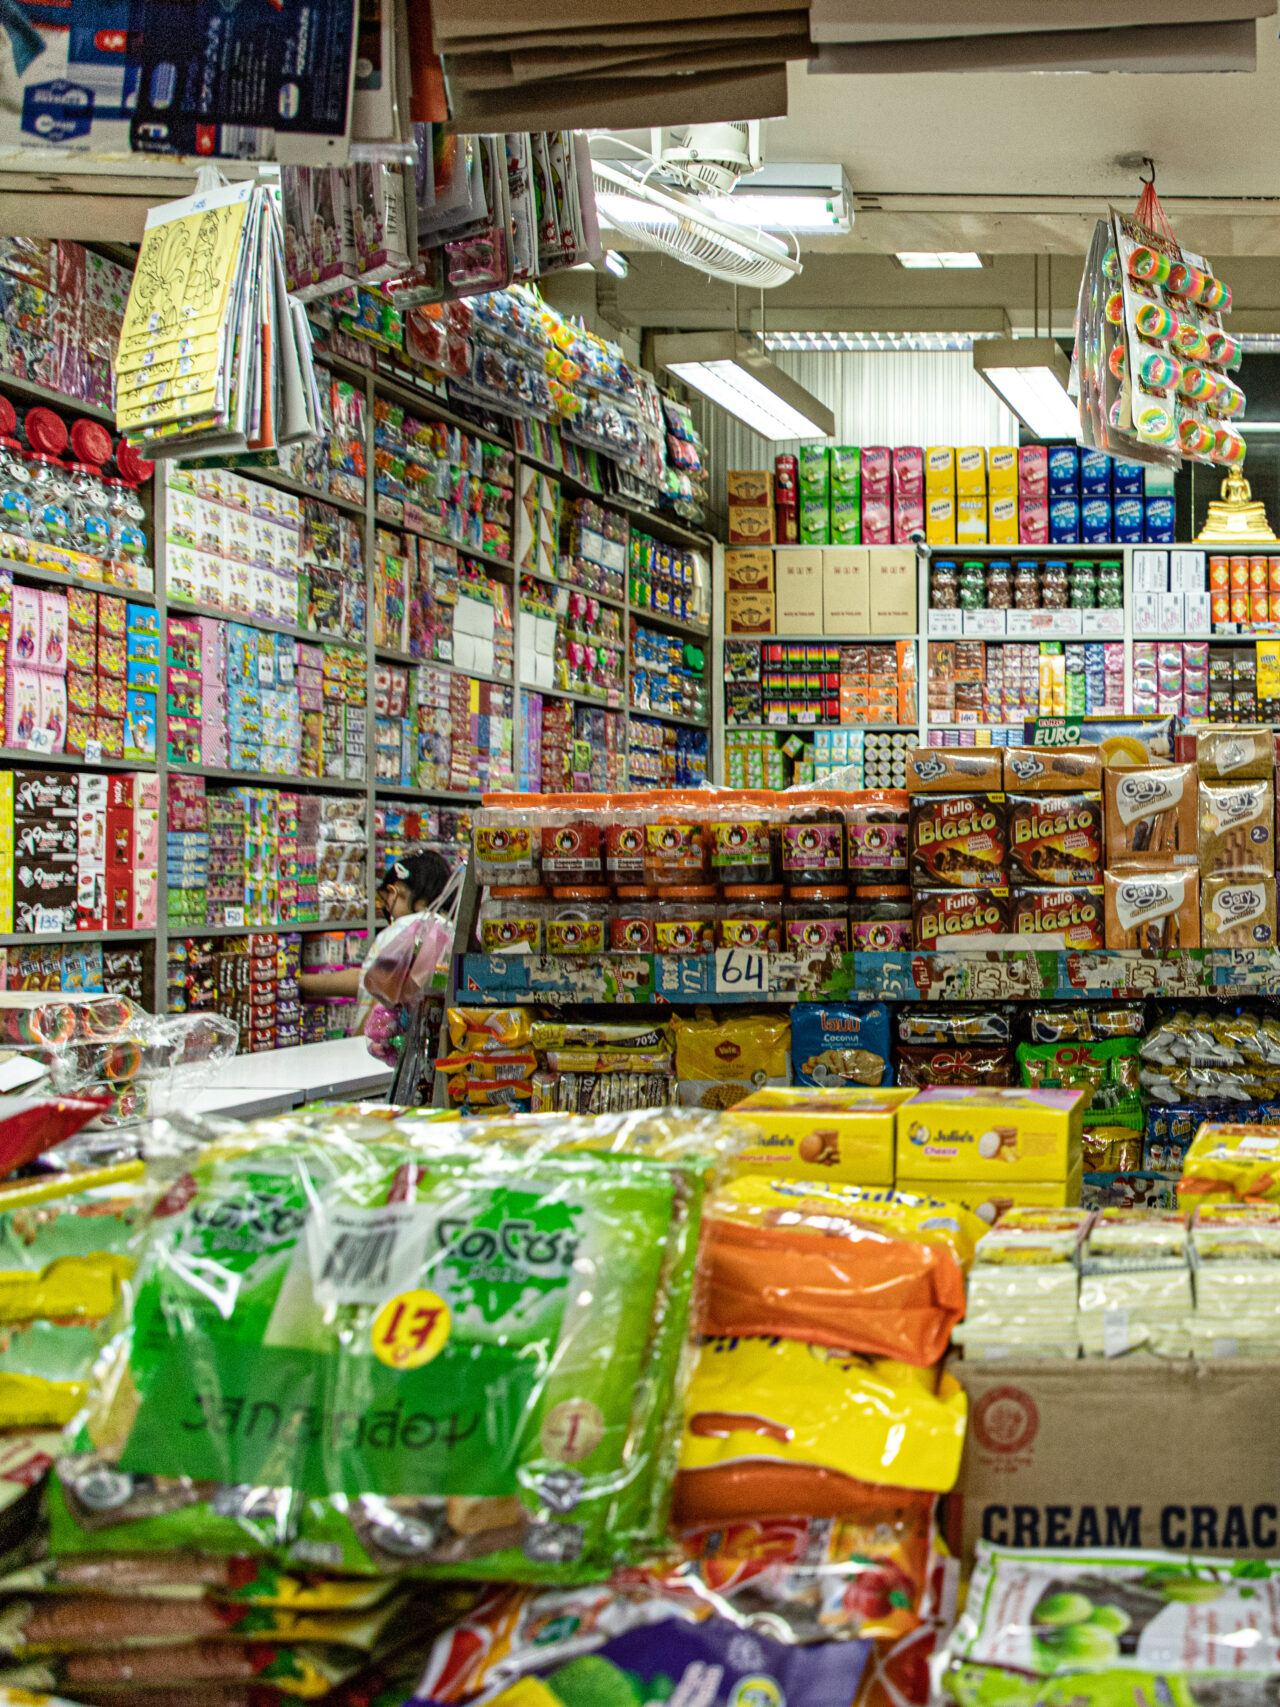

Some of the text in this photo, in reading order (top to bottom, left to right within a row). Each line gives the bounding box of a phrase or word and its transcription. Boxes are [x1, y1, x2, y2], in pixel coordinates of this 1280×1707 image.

[1035, 727, 1080, 745] EURO
[1122, 778, 1167, 801] Gery
[943, 800, 972, 817] Fullo
[919, 812, 996, 847] Blasto
[1015, 810, 1093, 845] Blasto
[946, 896, 976, 911] Fullo
[1043, 893, 1073, 908] Fullo
[1122, 884, 1167, 908] Gery
[1219, 891, 1260, 914] Gery
[922, 906, 1000, 940] Blasto
[1018, 905, 1096, 935] Blasto
[722, 950, 763, 990] 64
[824, 1034, 859, 1043] Coconut
[931, 1050, 978, 1074] OK
[1055, 1046, 1105, 1067] OK
[933, 1130, 974, 1143] Julie's
[982, 1505, 1141, 1548] CREAM
